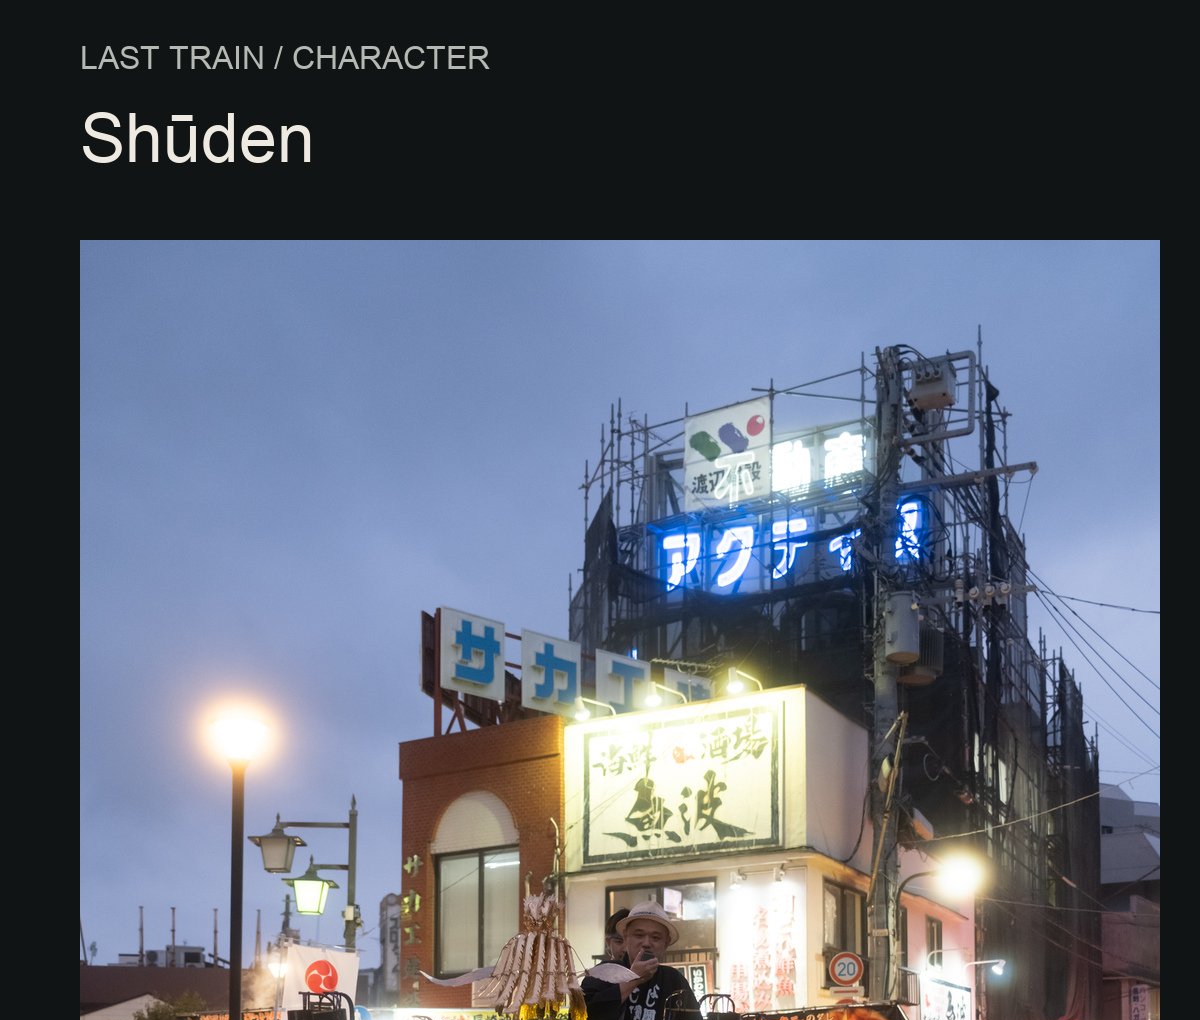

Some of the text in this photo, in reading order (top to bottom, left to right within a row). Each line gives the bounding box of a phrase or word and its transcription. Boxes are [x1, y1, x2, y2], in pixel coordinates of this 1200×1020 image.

[455, 620, 712, 715] サカエ
[835, 961, 857, 977] 20
